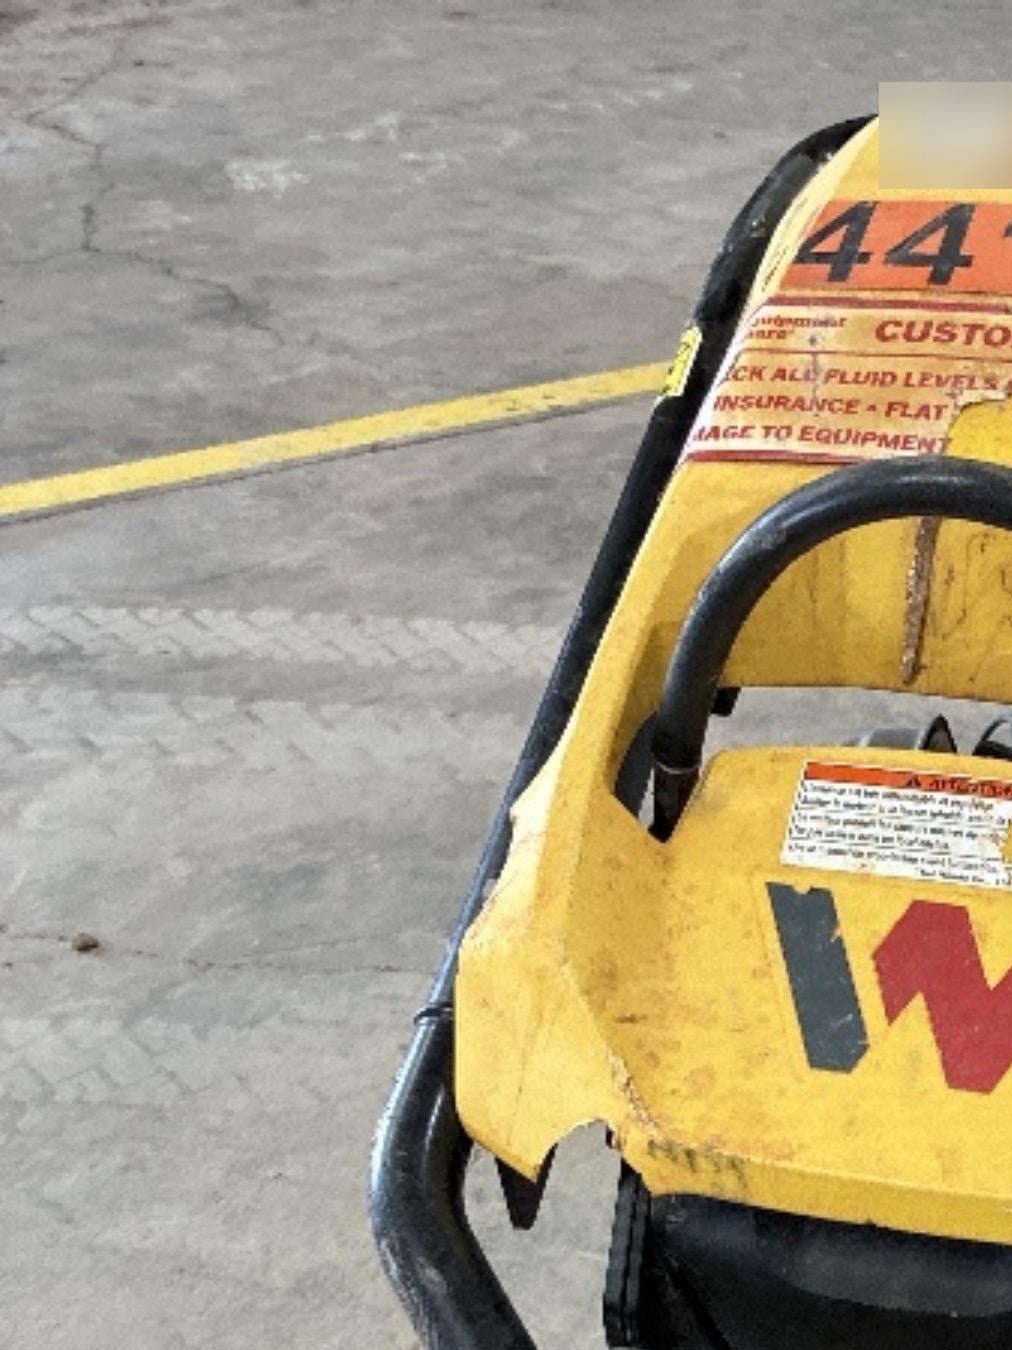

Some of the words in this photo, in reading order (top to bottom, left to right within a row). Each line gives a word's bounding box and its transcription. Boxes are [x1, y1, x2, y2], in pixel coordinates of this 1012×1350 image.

[770, 366, 816, 383] ALL
[823, 368, 898, 389] FLUID
[903, 371, 999, 391] LEVELS
[713, 395, 860, 415] INSURANCE
[884, 401, 949, 421] FLAT
[759, 424, 793, 442] TO
[797, 425, 953, 454] EQUIPMENT
